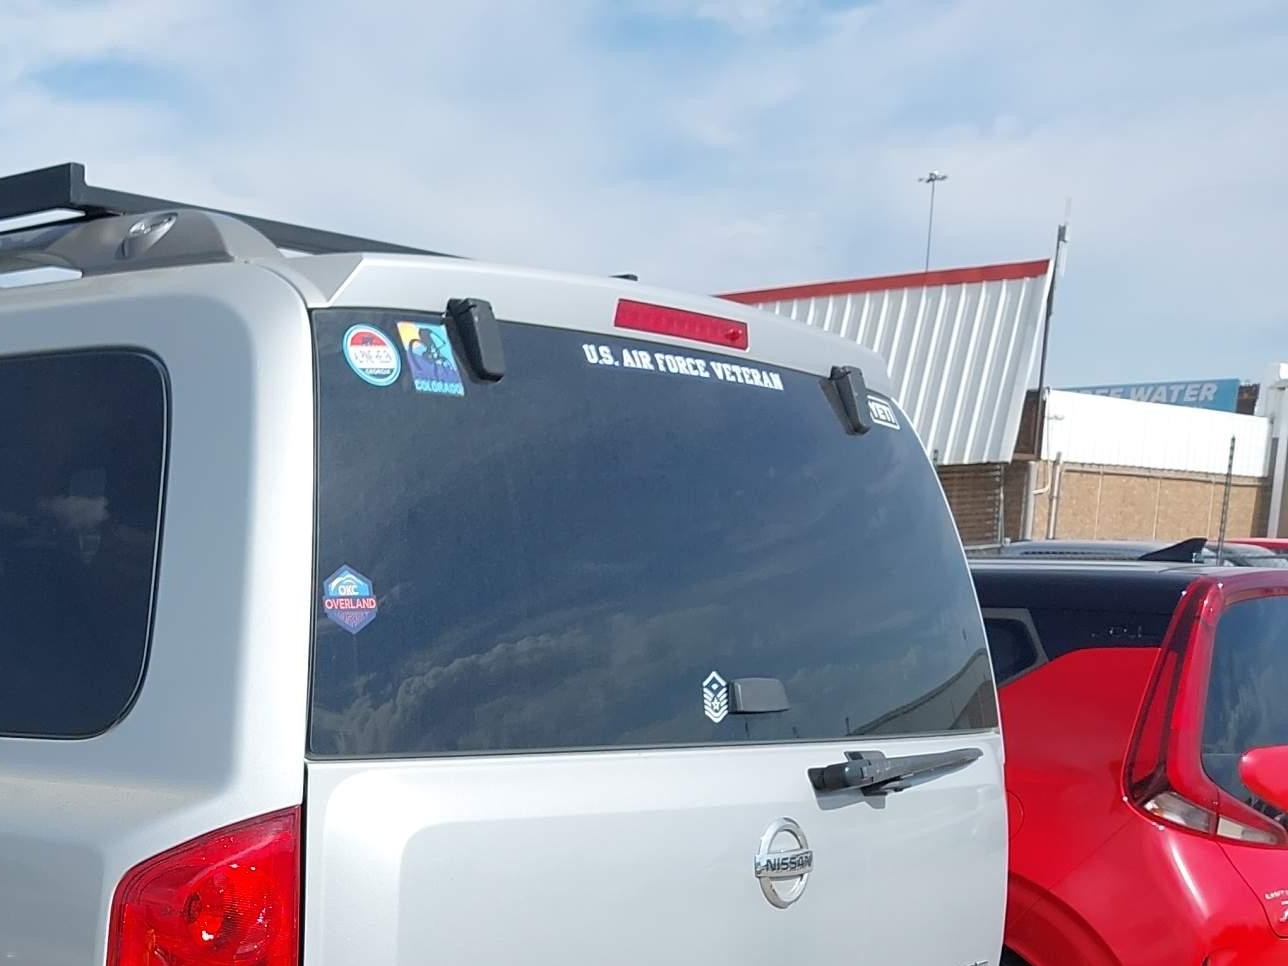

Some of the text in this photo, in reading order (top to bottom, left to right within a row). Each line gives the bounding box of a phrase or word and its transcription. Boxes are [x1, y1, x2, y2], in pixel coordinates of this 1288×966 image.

[582, 344, 784, 390] U.S. AIR FORCE VETERAN
[414, 379, 464, 396] COLORADO
[1130, 383, 1218, 403] WATER
[338, 584, 359, 596] OKC
[325, 597, 377, 610] OVERLAND
[765, 855, 812, 871] NISSAN
